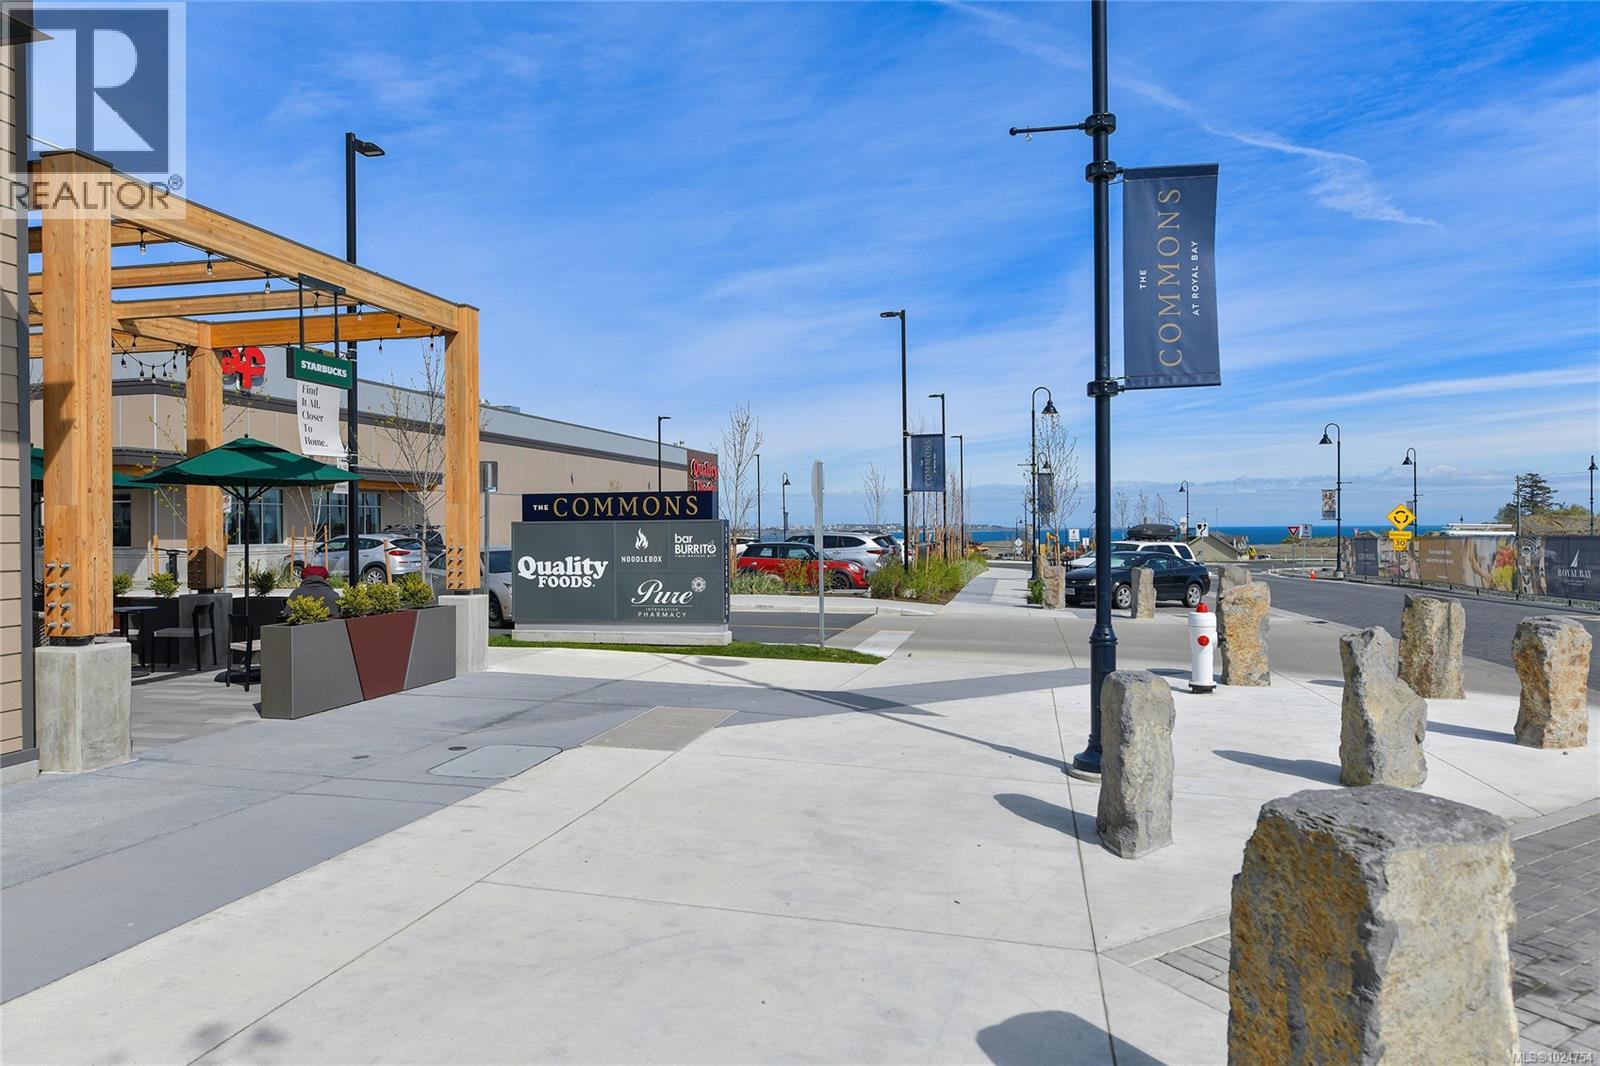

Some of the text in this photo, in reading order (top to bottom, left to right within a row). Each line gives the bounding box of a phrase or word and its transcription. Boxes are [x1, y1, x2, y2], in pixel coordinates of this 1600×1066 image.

[1157, 189, 1183, 367] COMMONS
[1191, 240, 1200, 316] AT ROYAL BAY
[301, 360, 347, 378] STARBUCKS
[302, 384, 318, 396] Find
[302, 410, 324, 422] Closer
[304, 424, 313, 433] To
[305, 436, 328, 447] Home.
[553, 495, 698, 517] COMMONS
[674, 533, 693, 543] bar
[674, 543, 717, 554] BURRITO
[621, 555, 662, 563] NOODLEBOX
[517, 555, 608, 579] Quality
[631, 579, 693, 604] Pure
